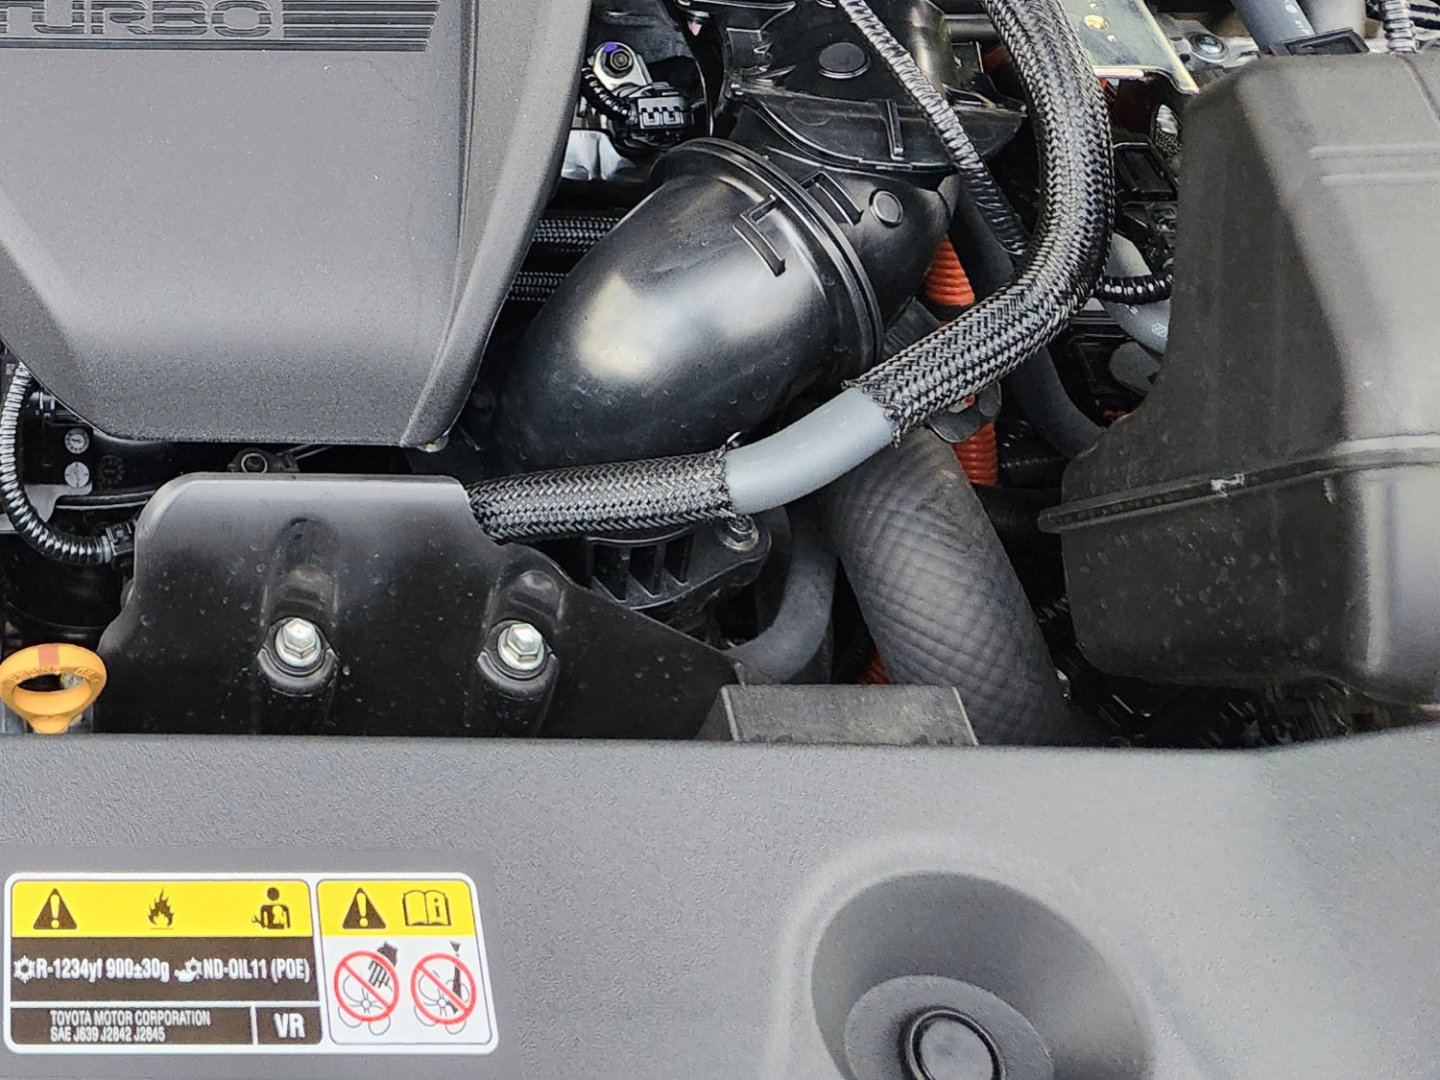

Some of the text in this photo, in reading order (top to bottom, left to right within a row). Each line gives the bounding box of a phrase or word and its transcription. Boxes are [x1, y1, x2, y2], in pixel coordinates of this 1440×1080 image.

[35, 957, 311, 984] R-1234yf 900±30g ND-OIL11 (POE)
[50, 1010, 211, 1027] TOYOTA MOTOR CORPORATION
[273, 1013, 306, 1038] VR
[50, 1026, 166, 1043] SAE J639 J2842 J2845
